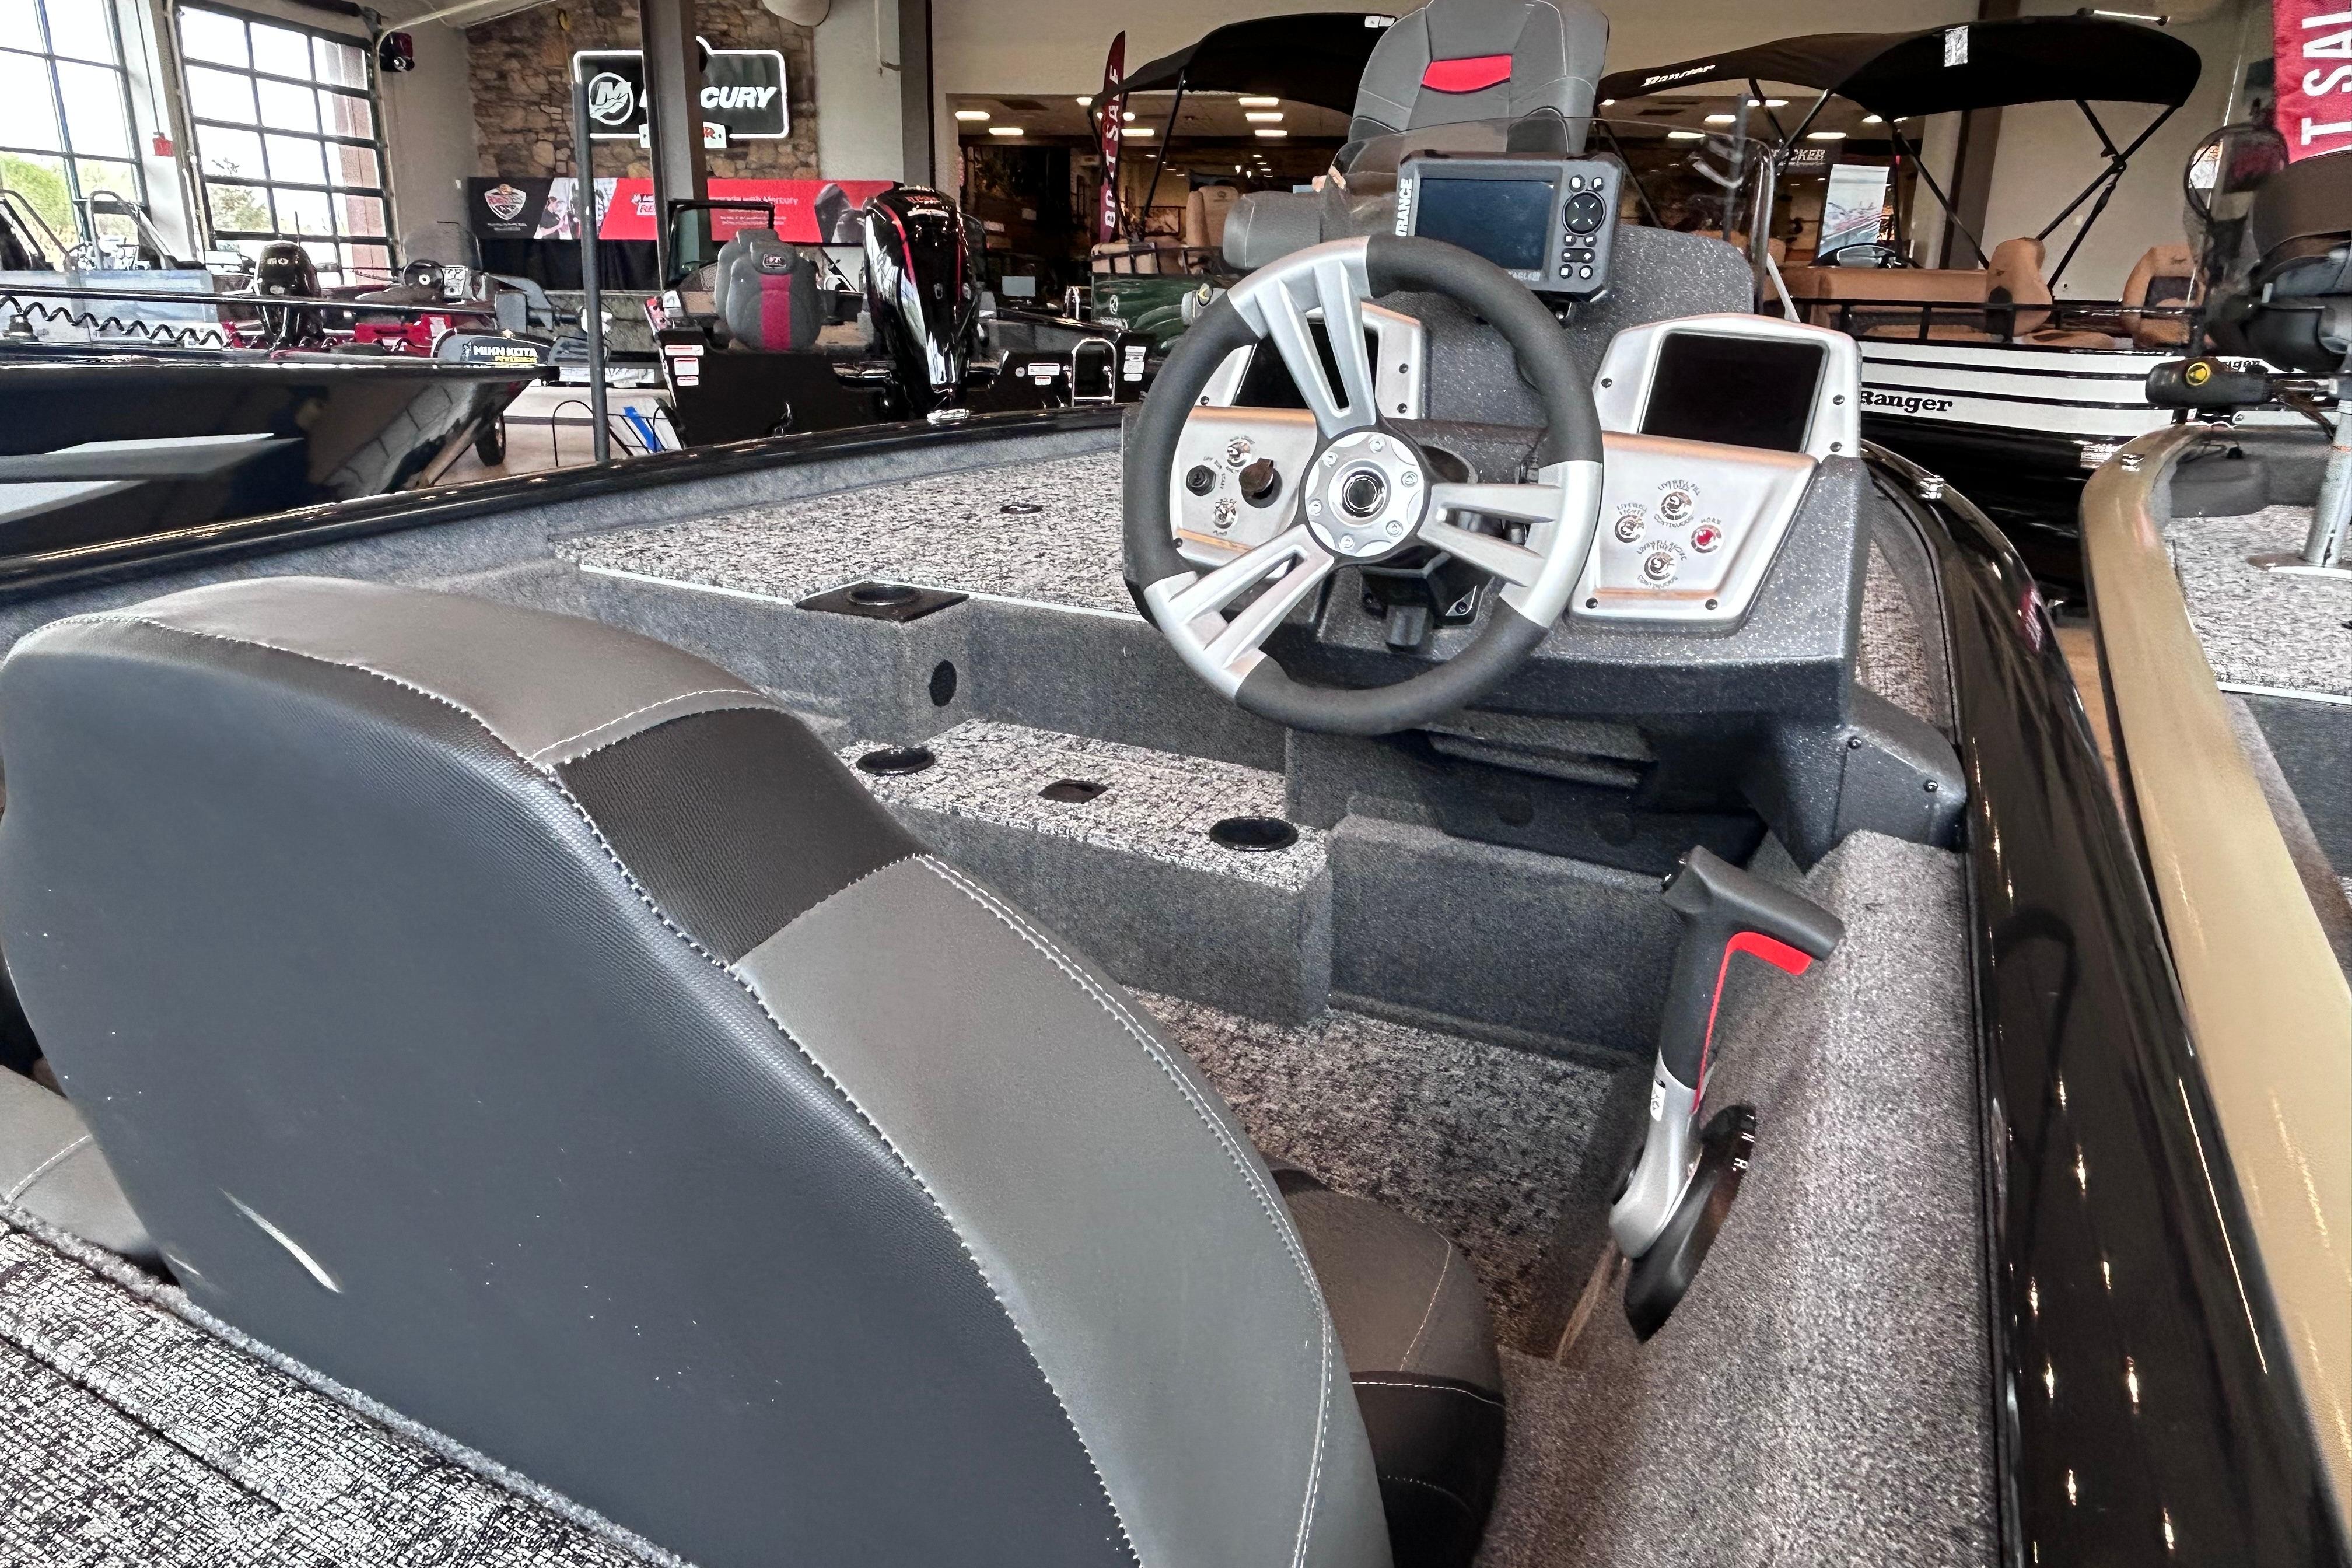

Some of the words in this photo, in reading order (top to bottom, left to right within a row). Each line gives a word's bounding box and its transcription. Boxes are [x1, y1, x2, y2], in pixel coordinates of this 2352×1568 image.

[1395, 178, 1413, 236] RANCE
[506, 346, 538, 358] KOTA
[1861, 390, 1954, 414] Ranger
